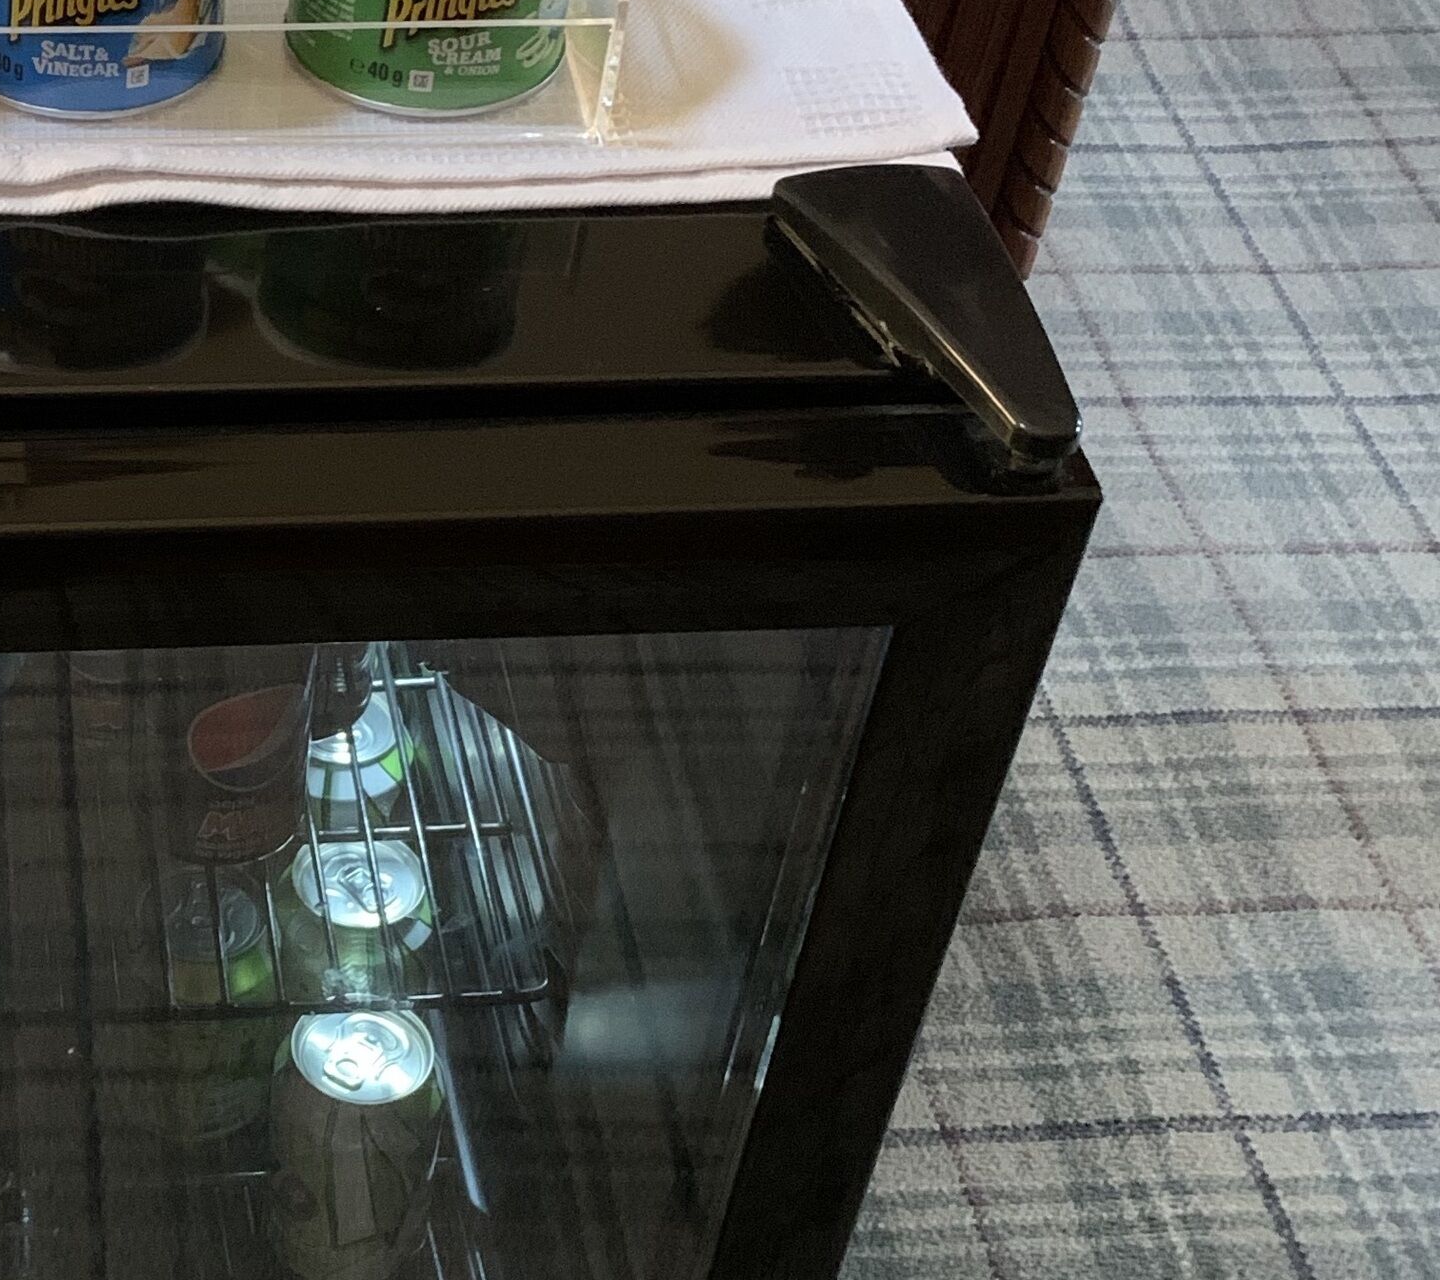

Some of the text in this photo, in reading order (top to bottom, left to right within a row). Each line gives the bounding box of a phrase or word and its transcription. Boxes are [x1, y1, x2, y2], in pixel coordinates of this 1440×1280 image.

[428, 31, 493, 55] SOUR
[431, 47, 502, 66] CREAM
[31, 57, 119, 78] VINEGAR
